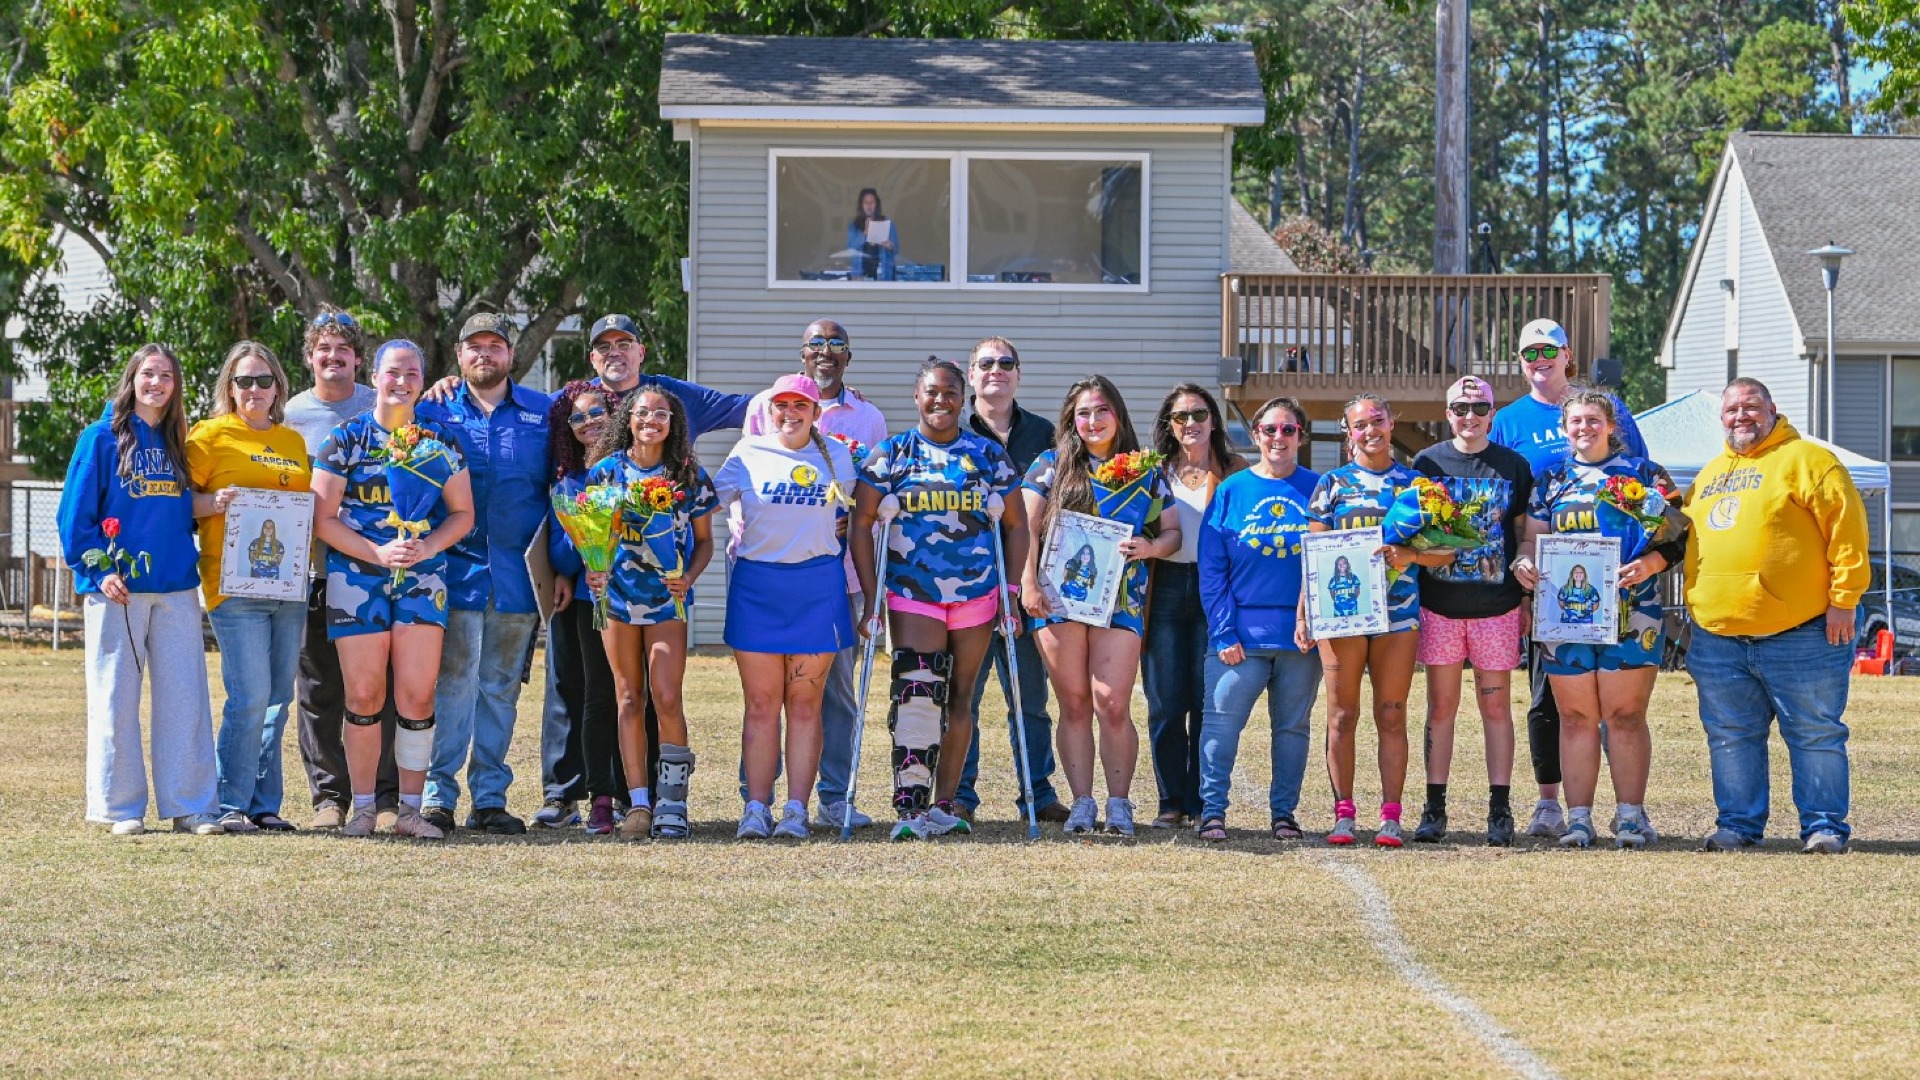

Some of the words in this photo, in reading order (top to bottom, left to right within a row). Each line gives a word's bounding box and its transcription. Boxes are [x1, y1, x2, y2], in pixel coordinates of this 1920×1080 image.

[250, 454, 301, 468] BEARCATS
[1712, 466, 1757, 484] LANDER
[761, 481, 829, 498] LANDE
[1699, 473, 1764, 500] BEARCATS
[771, 495, 828, 508] RUGBY
[906, 490, 983, 512] LANDER
[1556, 510, 1600, 532] LAN
